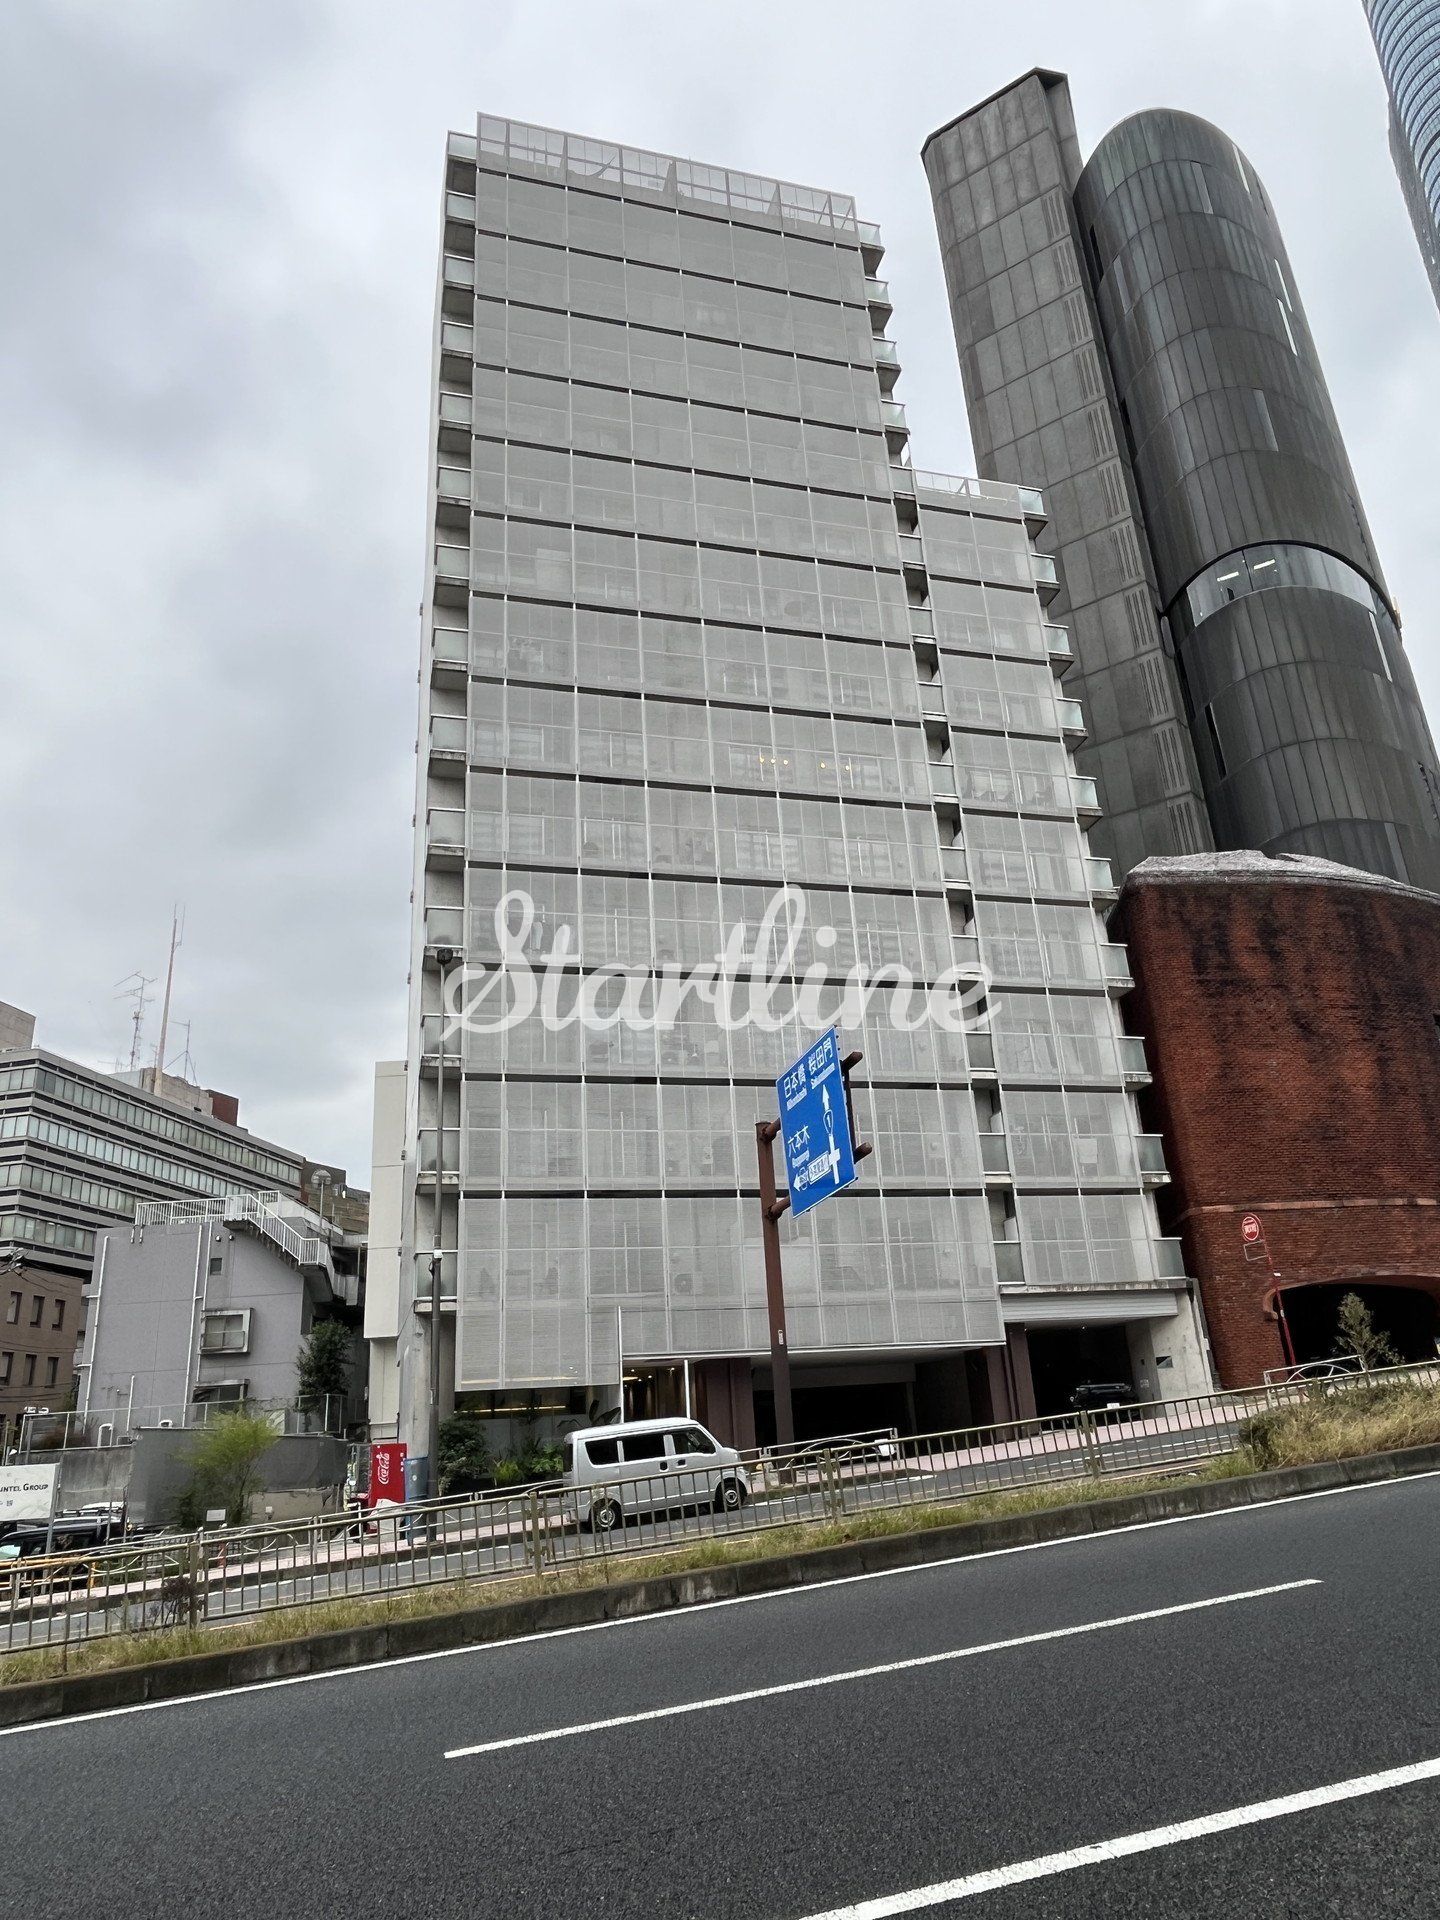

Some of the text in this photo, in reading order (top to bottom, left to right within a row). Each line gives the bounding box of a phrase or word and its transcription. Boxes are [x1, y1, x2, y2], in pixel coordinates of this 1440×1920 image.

[784, 1063, 806, 1098] 日本橋
[788, 1125, 810, 1157] 六本木
